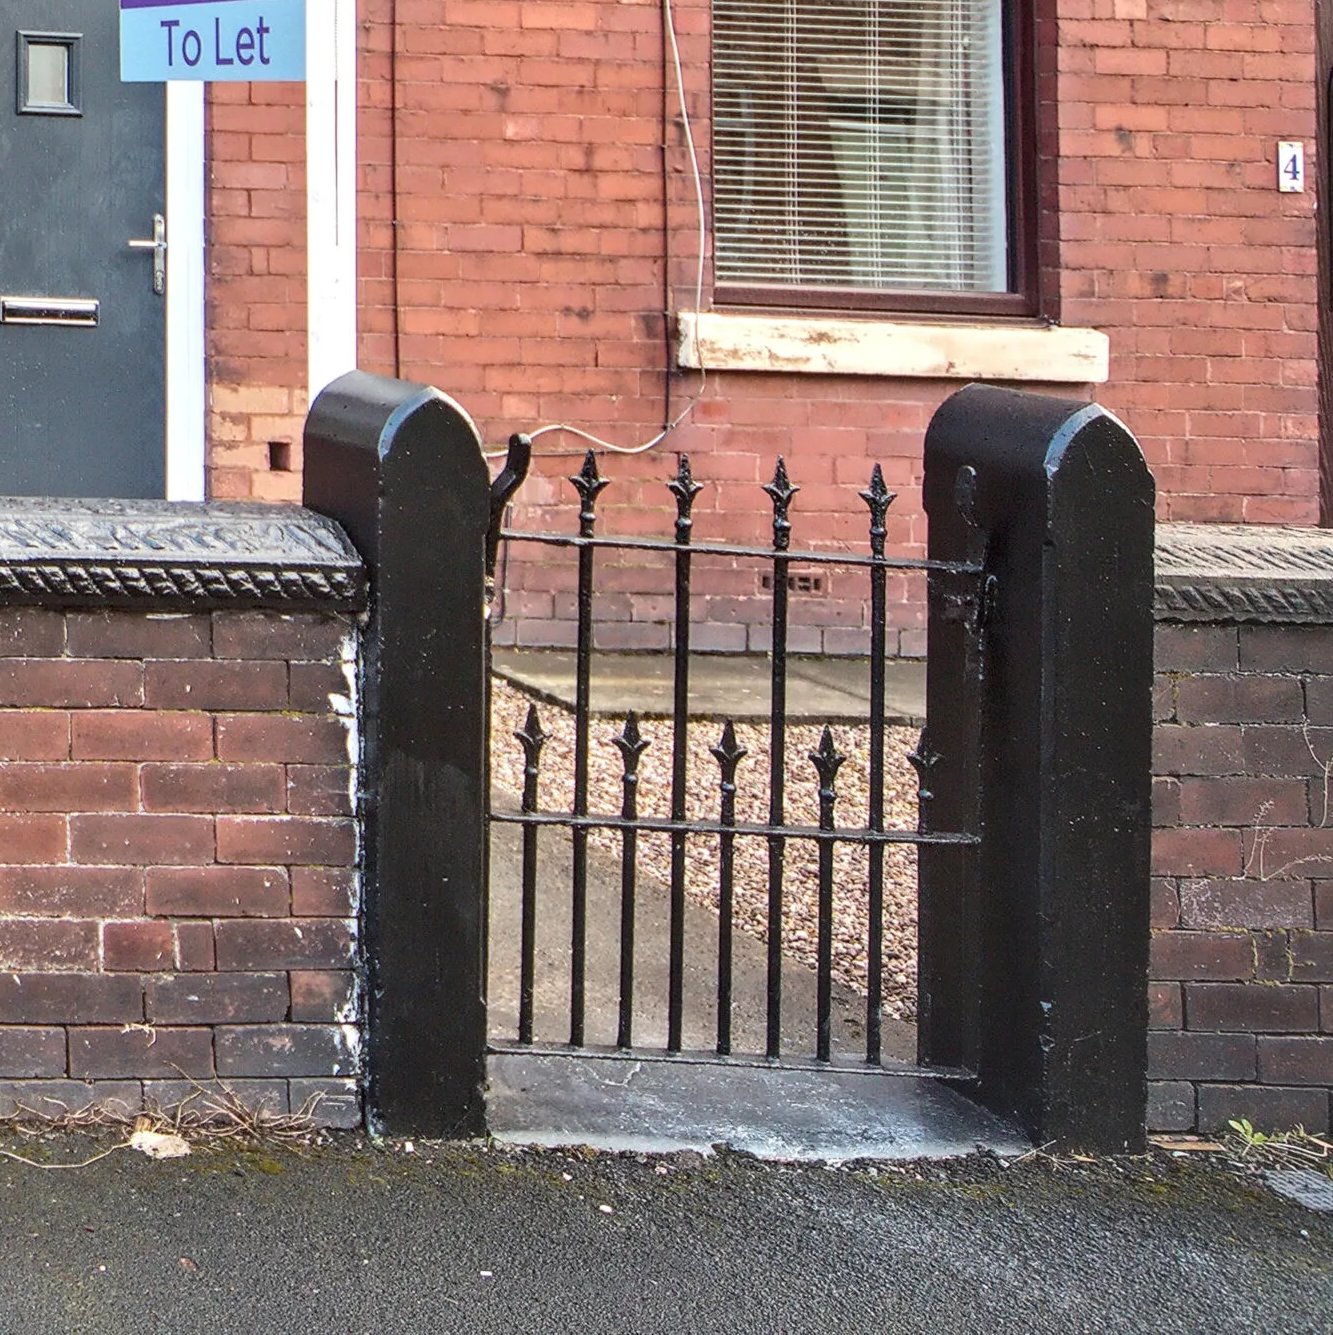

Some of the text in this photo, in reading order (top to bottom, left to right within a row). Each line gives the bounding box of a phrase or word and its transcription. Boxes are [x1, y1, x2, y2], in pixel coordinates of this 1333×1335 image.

[160, 16, 270, 66] To Let
[1283, 153, 1300, 181] 4
